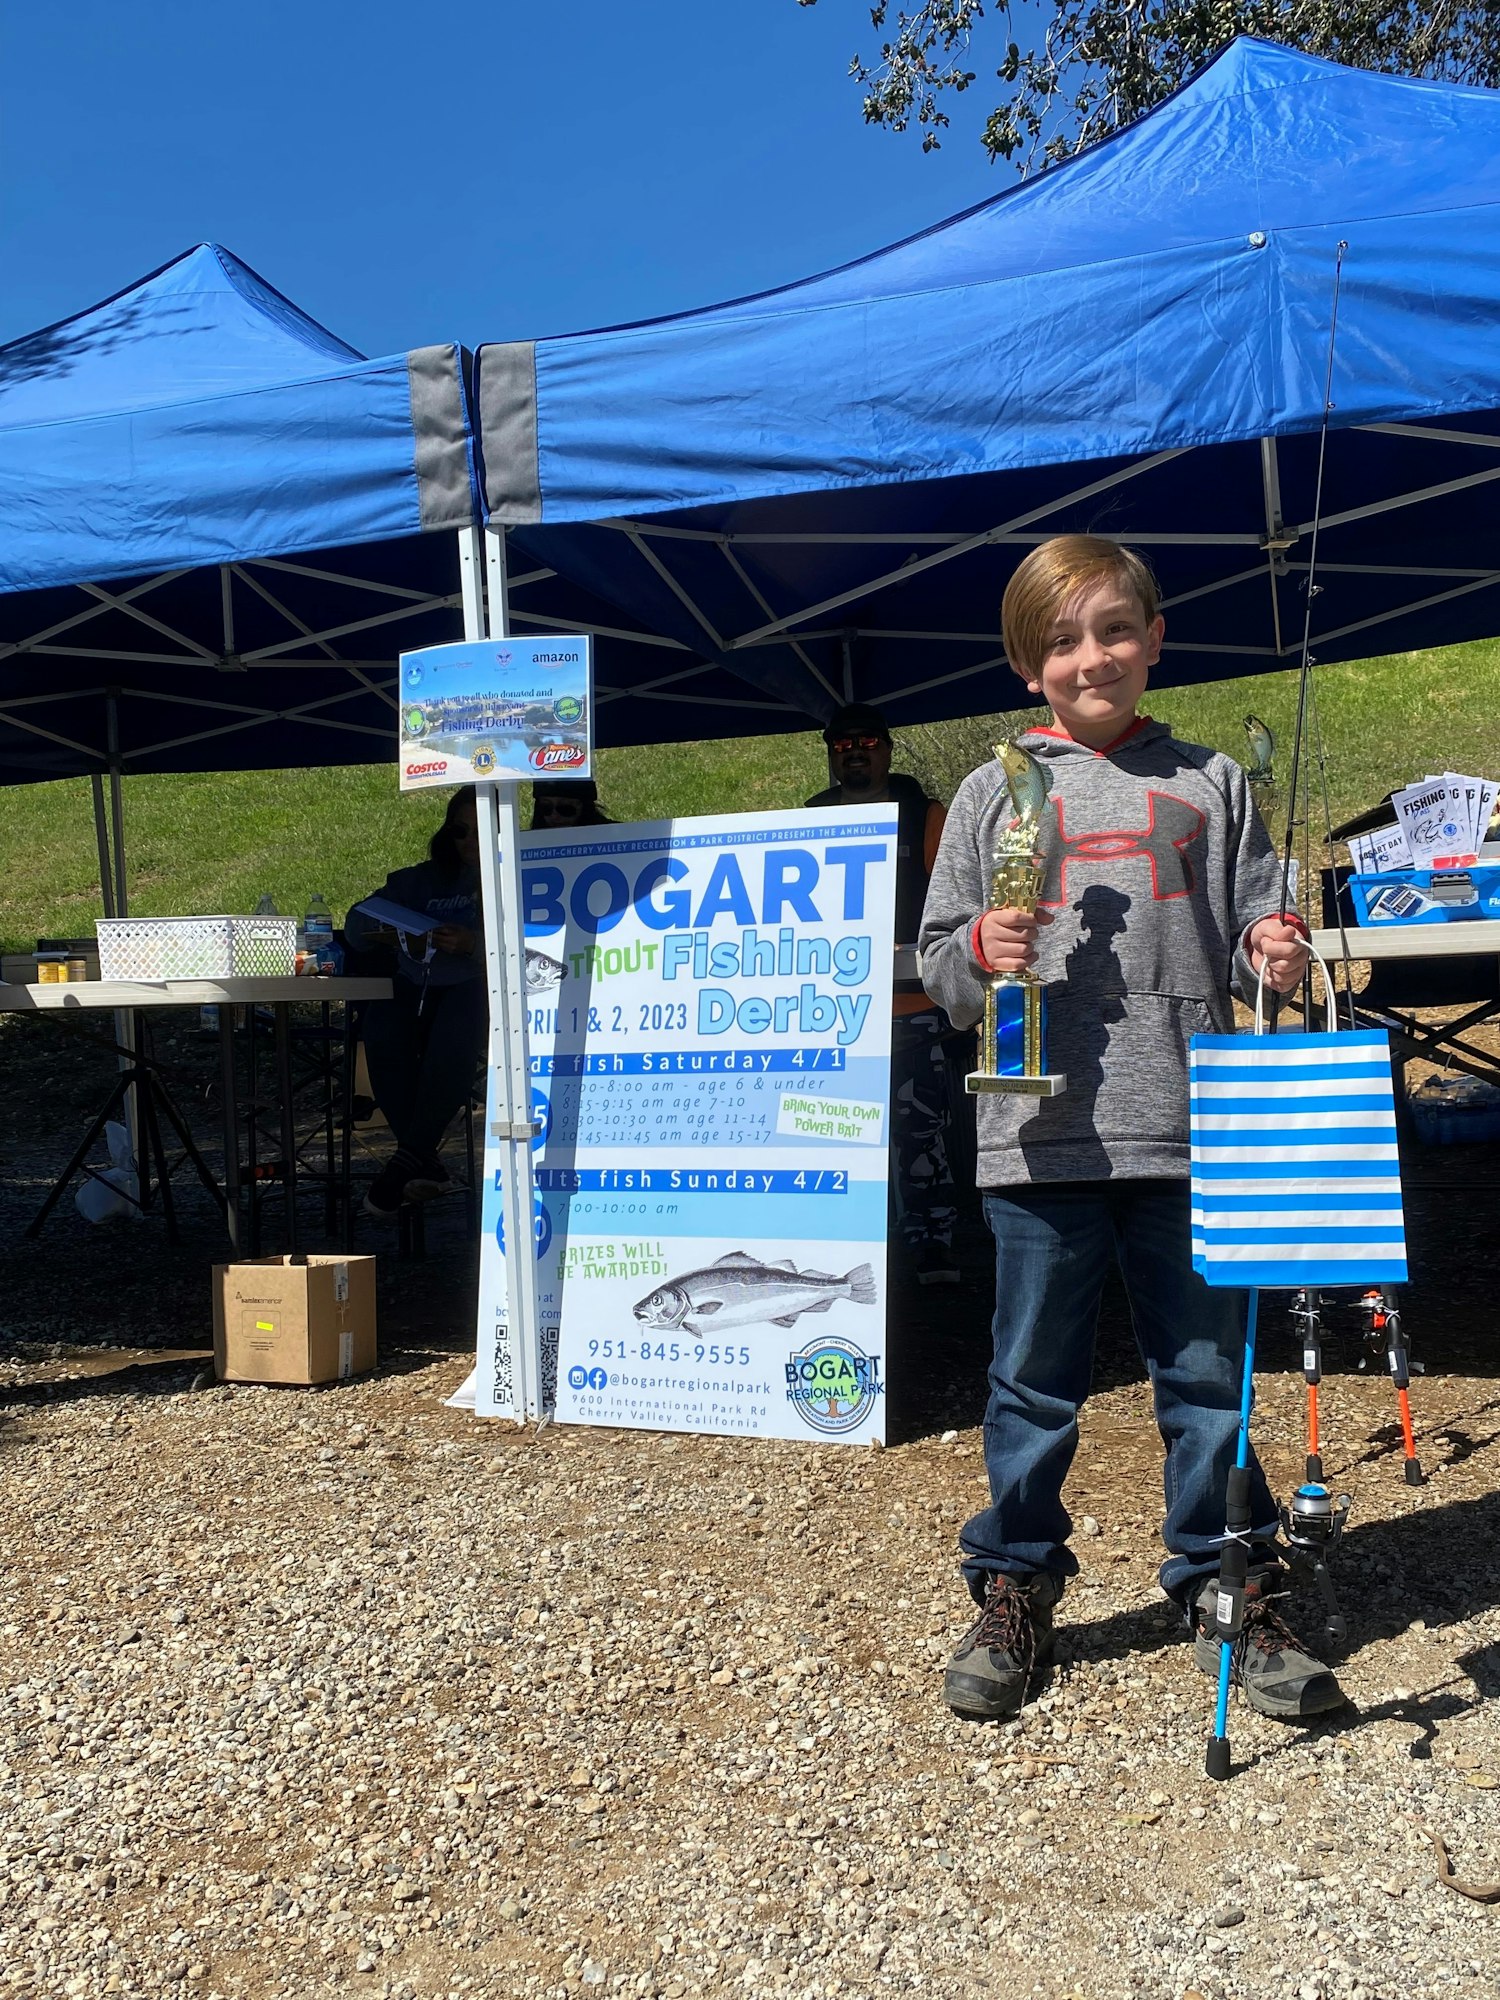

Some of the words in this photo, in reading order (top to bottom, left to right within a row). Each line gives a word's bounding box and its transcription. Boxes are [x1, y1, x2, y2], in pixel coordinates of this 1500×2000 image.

[532, 652, 579, 663] amazon
[500, 689, 535, 699] donated
[536, 688, 553, 697] and
[441, 717, 483, 733] Fishing
[486, 714, 525, 729] Derby
[406, 761, 448, 775] COSTCO
[529, 745, 585, 771] Cane's
[1403, 788, 1446, 816] FISHING
[522, 846, 594, 860] AUMONT-CHERRY
[597, 843, 628, 854] VALLEY
[631, 838, 687, 851] RECREATION
[690, 839, 697, 847] &
[701, 835, 724, 845] PARK
[727, 832, 768, 843] DISTRICT
[771, 830, 815, 841] PRESENTS
[819, 828, 836, 837] THE
[840, 826, 878, 836] ANNUAL
[1387, 836, 1403, 849] DAY
[521, 843, 887, 938] BOGART
[568, 939, 659, 983] TROUT
[662, 927, 872, 987] Fishing
[526, 1007, 562, 1034] PRIL
[571, 1007, 578, 1033] 1
[587, 1006, 602, 1033] &
[611, 1005, 628, 1036] 2,
[639, 1003, 688, 1031] 2023
[698, 983, 872, 1046] Derby
[530, 1056, 555, 1073] ds
[573, 1053, 624, 1072] fish
[642, 1050, 772, 1072] Saturday
[791, 1049, 842, 1068] 4/1
[562, 1079, 643, 1096] 7:00-8:00
[651, 1081, 674, 1092] am
[698, 1081, 726, 1095] age
[735, 1077, 745, 1091] 6
[753, 1076, 764, 1090] &
[774, 1075, 825, 1090] under
[562, 1097, 633, 1112] 8:15-9:15
[641, 1098, 664, 1108] am
[673, 1098, 701, 1112] age
[709, 1097, 745, 1111] 7-10
[782, 1098, 816, 1115] BRING
[817, 1101, 850, 1120] YOUR
[852, 1105, 880, 1120] OWN
[561, 1114, 647, 1128] 9:30-10:30
[655, 1114, 678, 1124] am
[687, 1114, 715, 1128] age
[724, 1113, 767, 1126] 11-14
[794, 1117, 834, 1137] POWER
[837, 1122, 862, 1138] BAIT
[561, 1131, 651, 1144] 10:45-11:45
[660, 1131, 682, 1141] am
[691, 1131, 719, 1145] age
[728, 1130, 771, 1144] 15-17
[600, 1170, 651, 1188] fish
[670, 1169, 774, 1193] Sunday
[793, 1171, 845, 1190] 4/2
[557, 1203, 647, 1216] 7:00-10:00
[655, 1204, 678, 1215] am
[559, 1244, 615, 1266] PRIZES
[622, 1241, 664, 1259] WILL
[557, 1265, 574, 1281] BE
[583, 1260, 668, 1281] AWARDED!
[588, 1338, 750, 1366] 951-845-9555
[784, 1355, 881, 1383] BOGART
[609, 1373, 771, 1395] @bogartregionalpark
[786, 1385, 848, 1402] REGIONAL
[850, 1382, 885, 1396] PARK
[572, 1394, 603, 1405] 9600
[610, 1396, 703, 1412] International
[712, 1403, 742, 1414] Park
[750, 1405, 766, 1416] Rd
[579, 1407, 623, 1420] Cherry
[631, 1410, 677, 1424] Valley,
[685, 1414, 758, 1428] California
